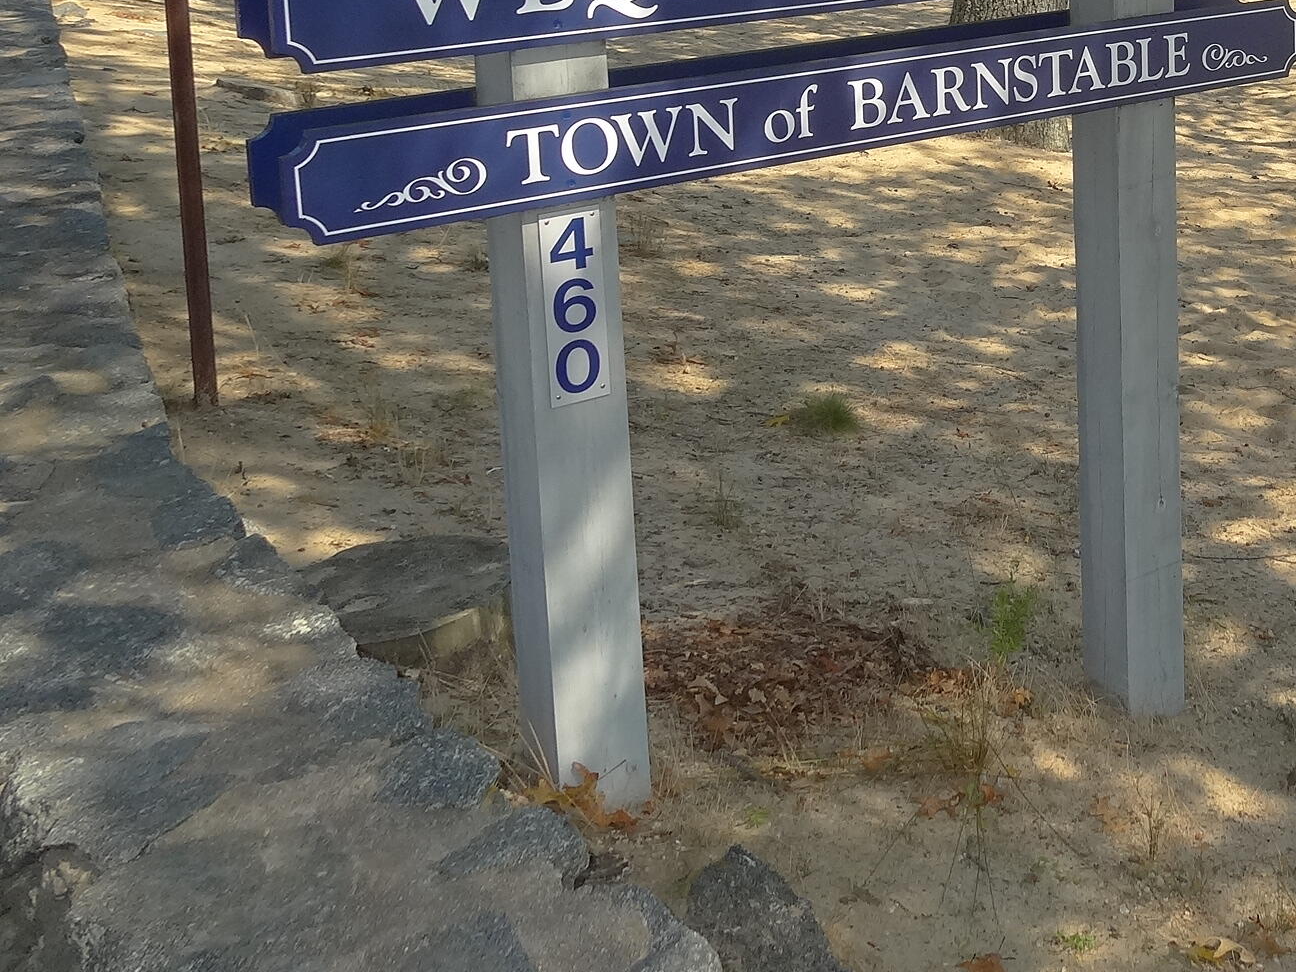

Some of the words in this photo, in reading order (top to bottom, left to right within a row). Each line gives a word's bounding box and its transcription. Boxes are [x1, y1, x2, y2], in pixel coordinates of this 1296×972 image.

[505, 97, 738, 184] TOWN
[764, 84, 820, 143] of
[848, 33, 1190, 130] BARNSTABLE
[549, 216, 601, 394] 460
